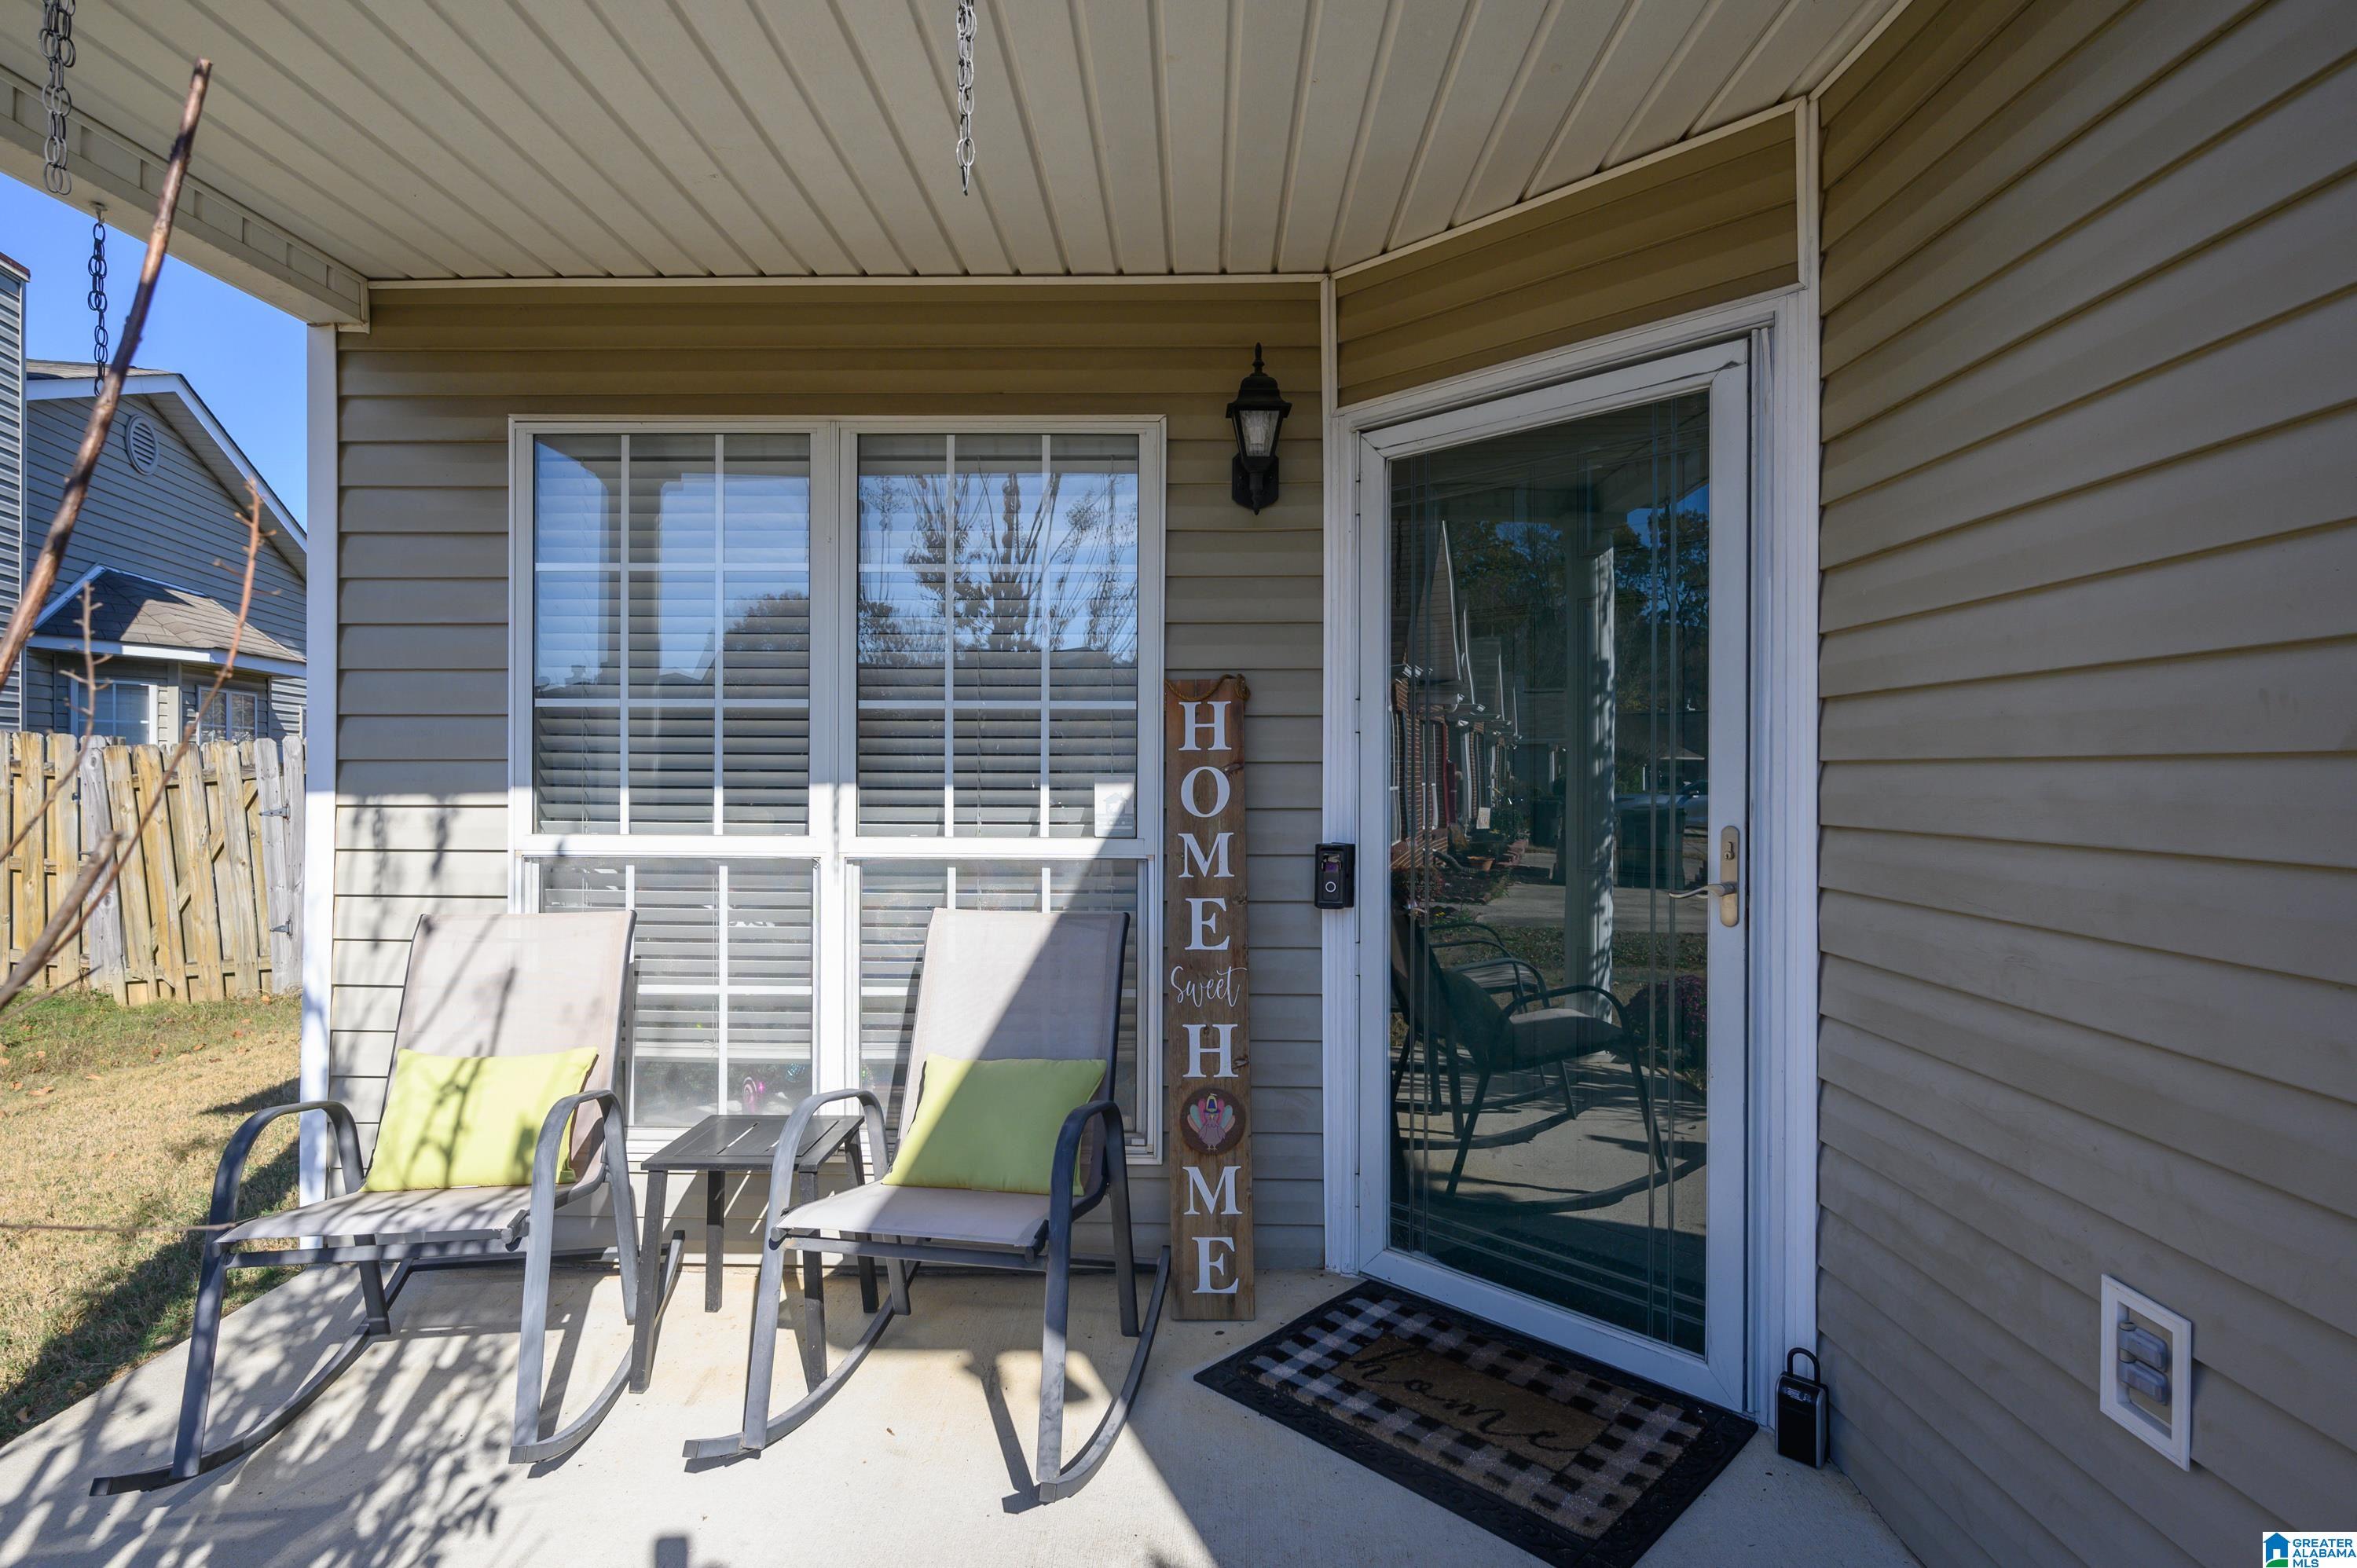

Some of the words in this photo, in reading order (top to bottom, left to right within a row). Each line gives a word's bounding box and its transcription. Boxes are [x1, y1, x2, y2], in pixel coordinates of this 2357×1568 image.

[1178, 700, 1235, 951] HOME
[1170, 965, 1248, 1007] Sweet
[1182, 1024, 1244, 1294] HME
[1343, 1345, 1586, 1453] home
